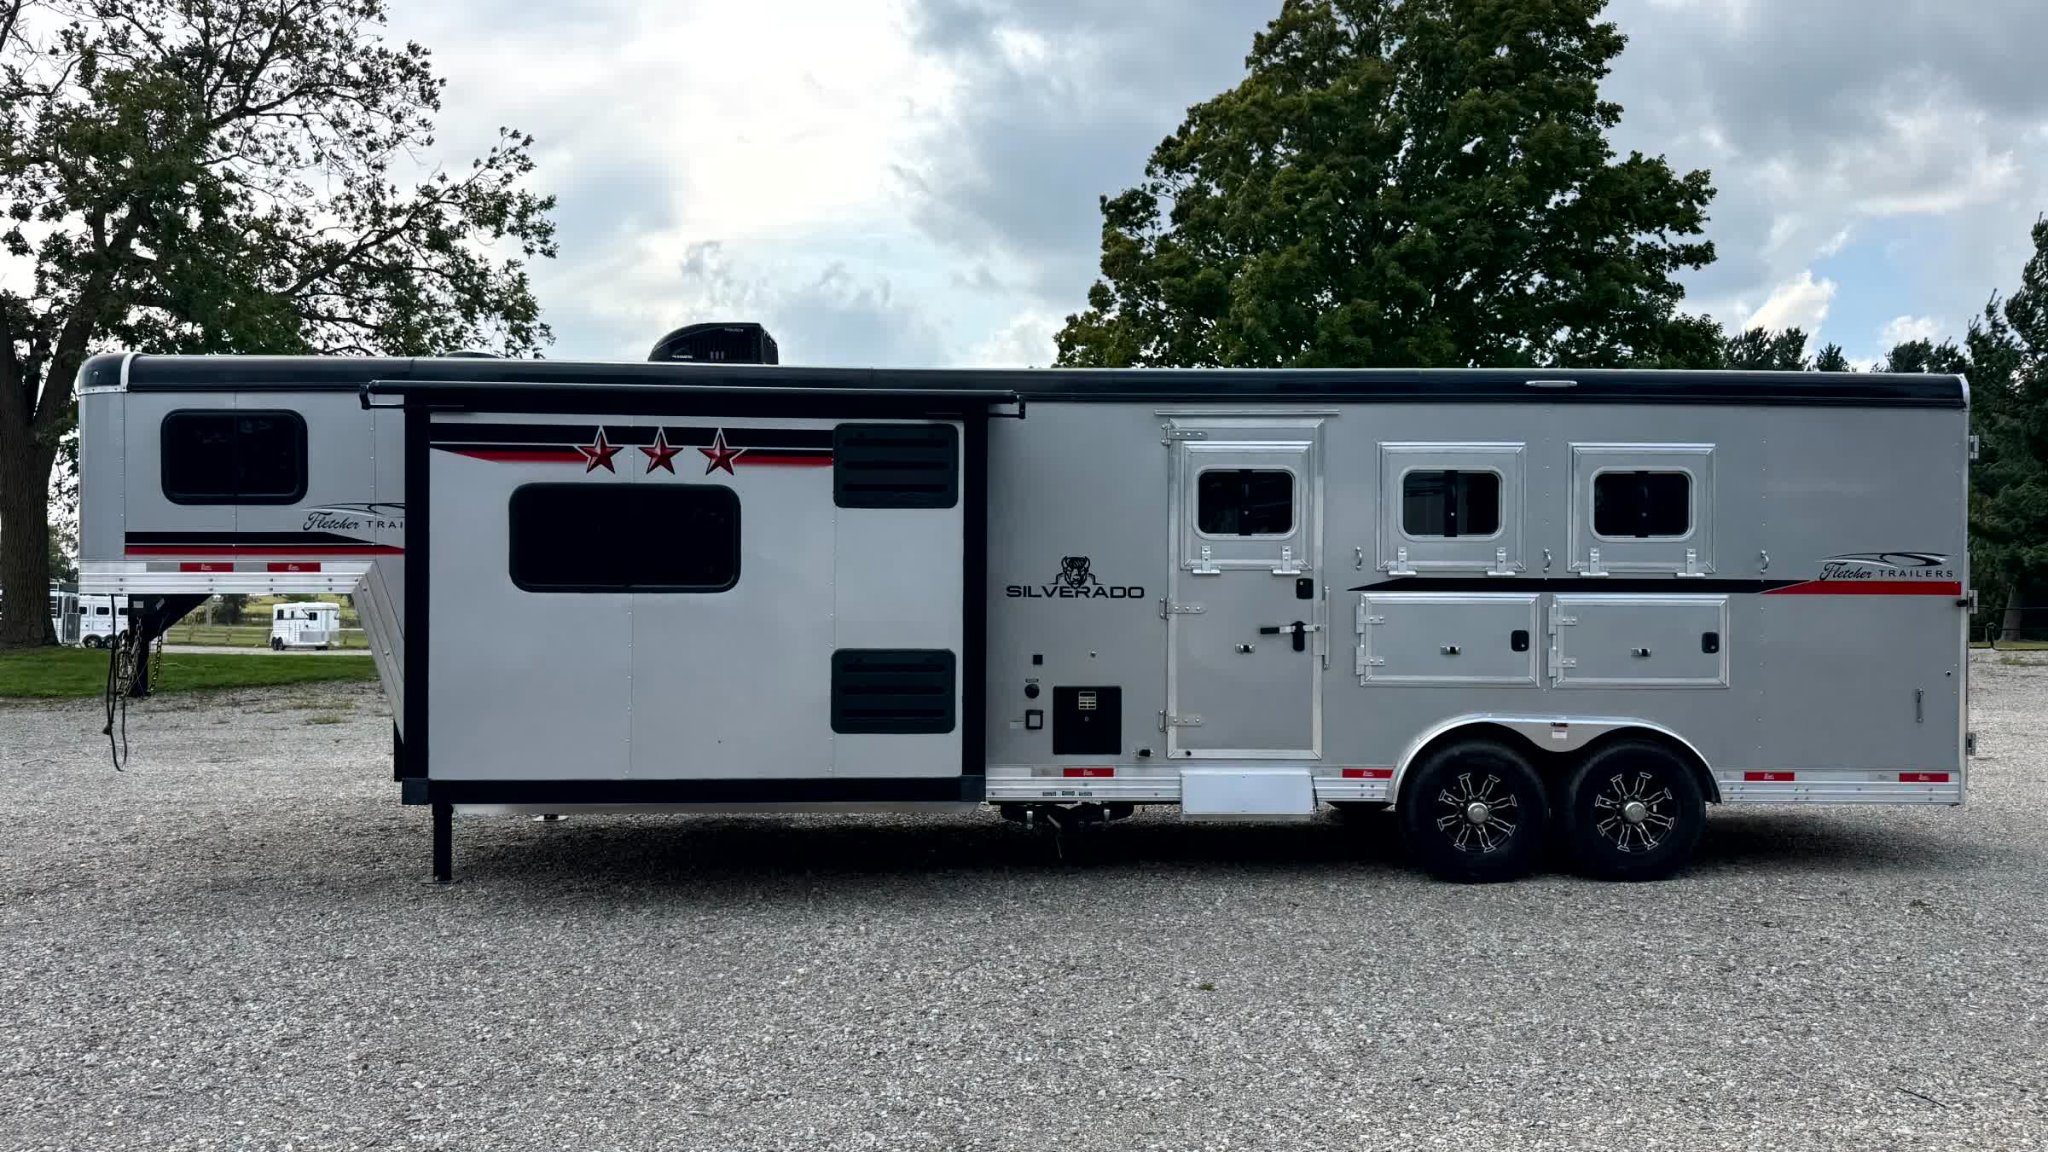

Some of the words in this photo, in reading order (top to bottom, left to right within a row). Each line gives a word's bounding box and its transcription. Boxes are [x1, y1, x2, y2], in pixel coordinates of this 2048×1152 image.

[302, 511, 360, 531] Fletcher
[366, 520, 403, 529] TRAI
[1819, 562, 1873, 581] Fletcher
[1879, 569, 1954, 578] TRAILERS
[1006, 585, 1145, 599] SILVERADO
